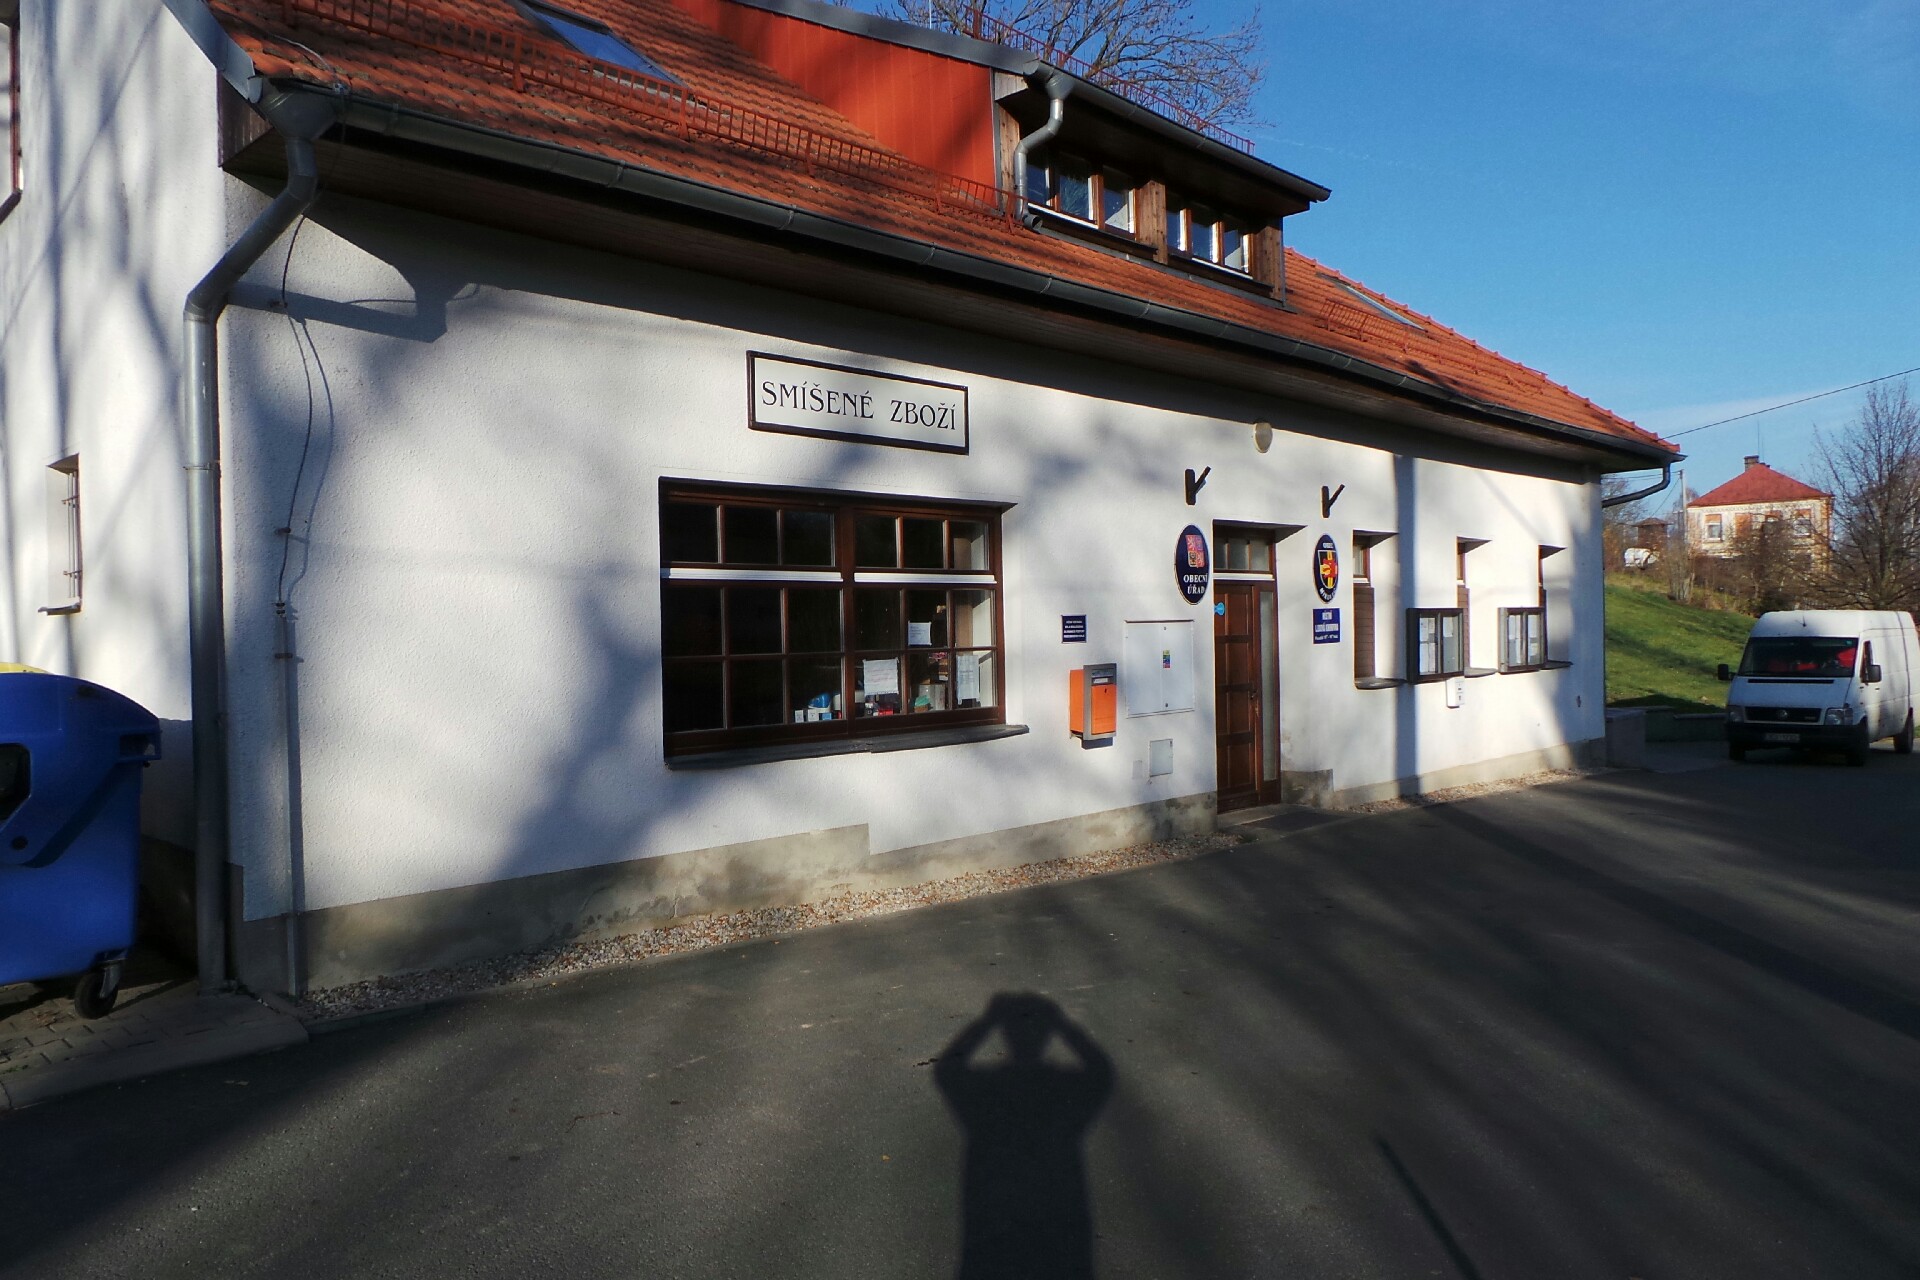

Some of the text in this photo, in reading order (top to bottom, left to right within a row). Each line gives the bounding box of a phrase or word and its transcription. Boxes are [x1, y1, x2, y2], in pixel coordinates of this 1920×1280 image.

[762, 381, 956, 430] SMÍŠENÉ ZBOŽÍ
[1183, 573, 1208, 583] OBECNÍ
[1187, 584, 1206, 594] ÚŘAD
